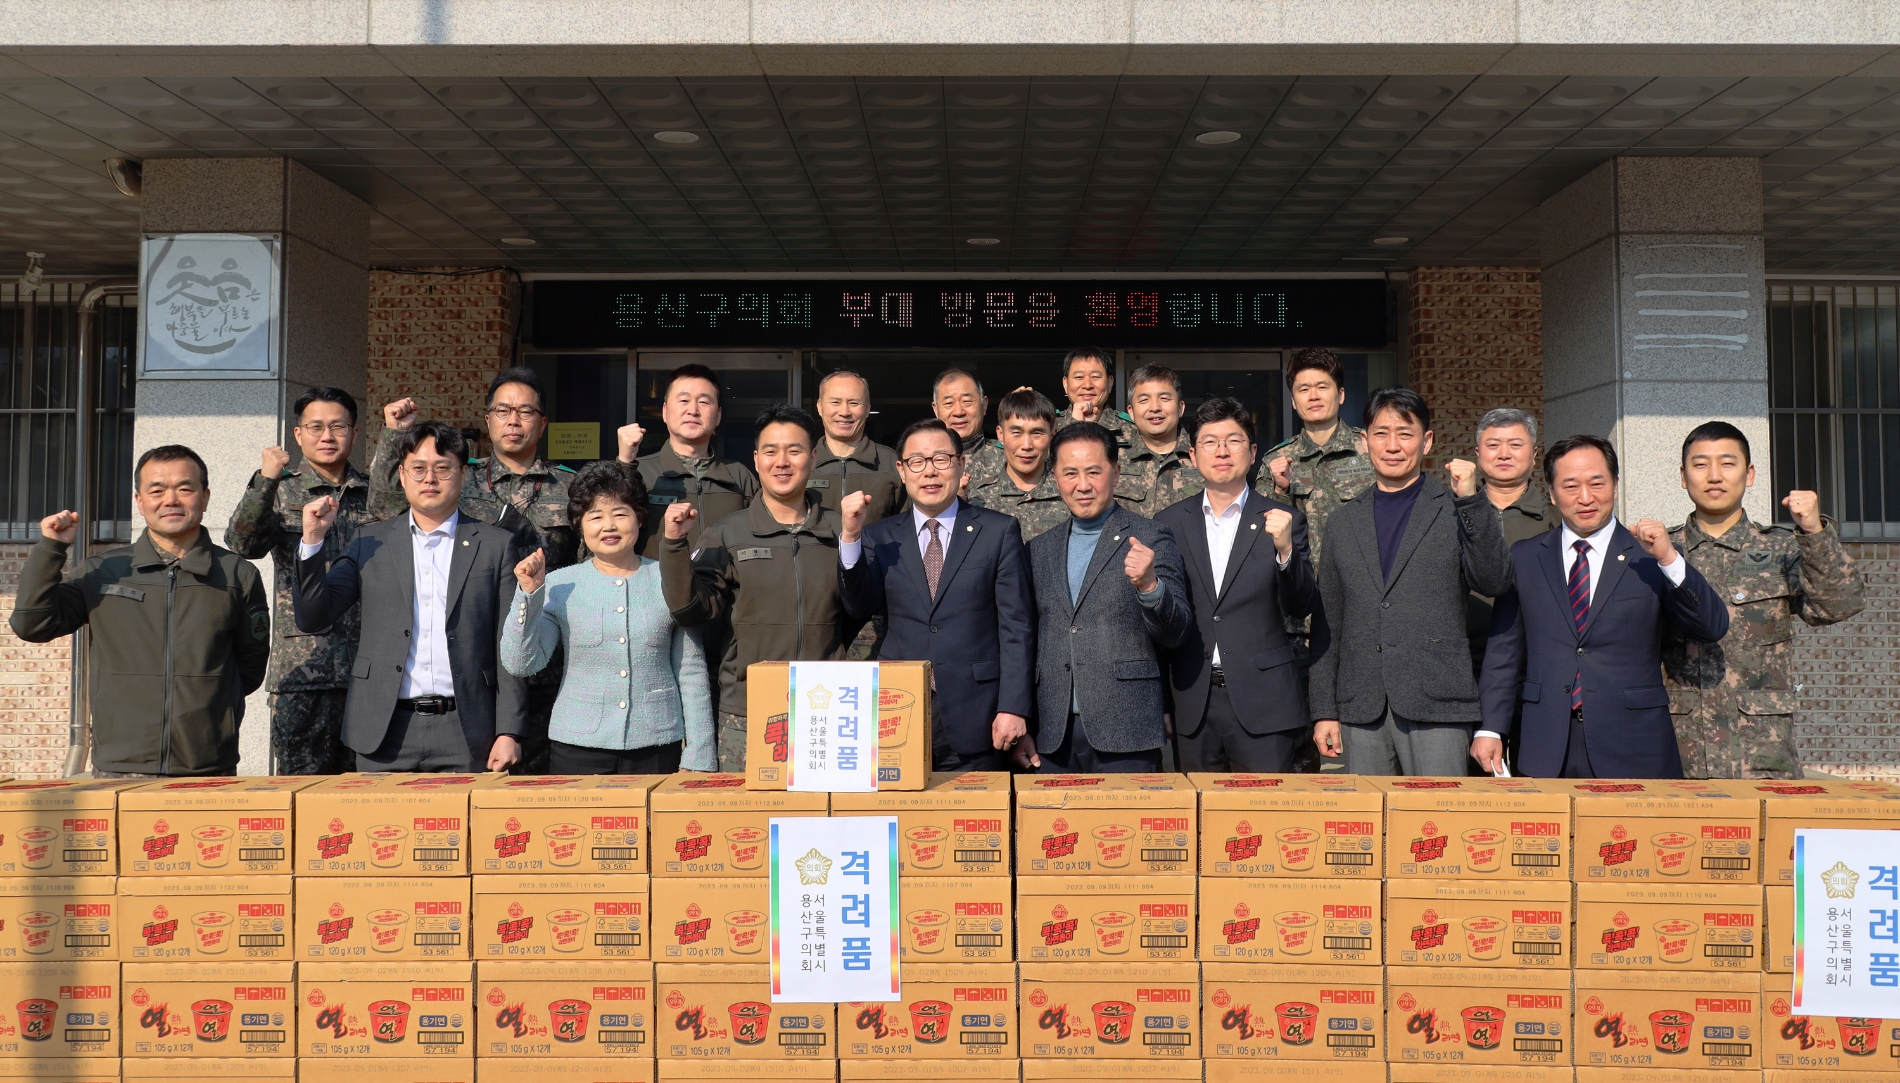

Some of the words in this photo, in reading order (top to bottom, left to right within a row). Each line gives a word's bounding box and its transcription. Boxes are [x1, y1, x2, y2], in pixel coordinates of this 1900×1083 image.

[218, 304, 250, 325] 부르는
[612, 293, 811, 327] 용산구의회
[839, 292, 912, 327] 부대
[941, 292, 1059, 328] 방문을
[837, 686, 859, 770] 격려품
[808, 716, 818, 771] 용산구의회
[818, 716, 828, 771] 서울특별시
[877, 769, 898, 780] 기면
[154, 862, 165, 871] 120
[328, 861, 339, 870] 120
[506, 860, 516, 869] 120
[686, 863, 698, 872] 120
[806, 863, 822, 873] 의회
[1053, 861, 1064, 870] 120
[1236, 864, 1248, 872] 120
[1422, 865, 1433, 874] 120
[1610, 868, 1622, 877] 120
[1832, 876, 1848, 886] 의회
[840, 850, 872, 971] 격려품
[1868, 865, 1900, 987] 격려품
[800, 894, 813, 973] 용산구의회
[813, 894, 827, 972] 서울특별시
[1825, 907, 1839, 986] 용산구의회
[1840, 907, 1853, 987] 서울특별시
[1422, 953, 1434, 961] 120
[141, 1008, 171, 1038] 열
[244, 1015, 267, 1024] 용기면
[317, 1008, 348, 1039] 열
[422, 1017, 445, 1026] 용기면
[496, 1008, 528, 1038] 열
[602, 1016, 626, 1025] 용기면
[782, 1018, 807, 1027] 용기면
[857, 1009, 889, 1040] 열
[964, 1016, 988, 1025] 용기면
[1039, 1009, 1071, 1040] 열
[1147, 1018, 1172, 1027] 용기면
[1222, 1009, 1254, 1040] 열
[1331, 1019, 1355, 1028] 용기면
[173, 1025, 190, 1036] 라면
[676, 1010, 708, 1041] 열
[1407, 1013, 1440, 1044] 열
[1517, 1024, 1542, 1033] 용기면
[349, 1026, 367, 1038] 라면
[529, 1026, 548, 1037] 라면
[709, 1028, 727, 1039] 라면
[890, 1027, 908, 1038] 라면
[1073, 1027, 1091, 1038] 라면
[1256, 1028, 1274, 1039] 라면
[1595, 1017, 1628, 1048] 열
[1706, 1028, 1732, 1037] 용기면
[1781, 1019, 1815, 1050] 열
[1442, 1032, 1460, 1043] 라면
[1629, 1036, 1648, 1048] 라면
[1816, 1038, 1836, 1050] 라면
[1797, 1057, 1809, 1065] 105
